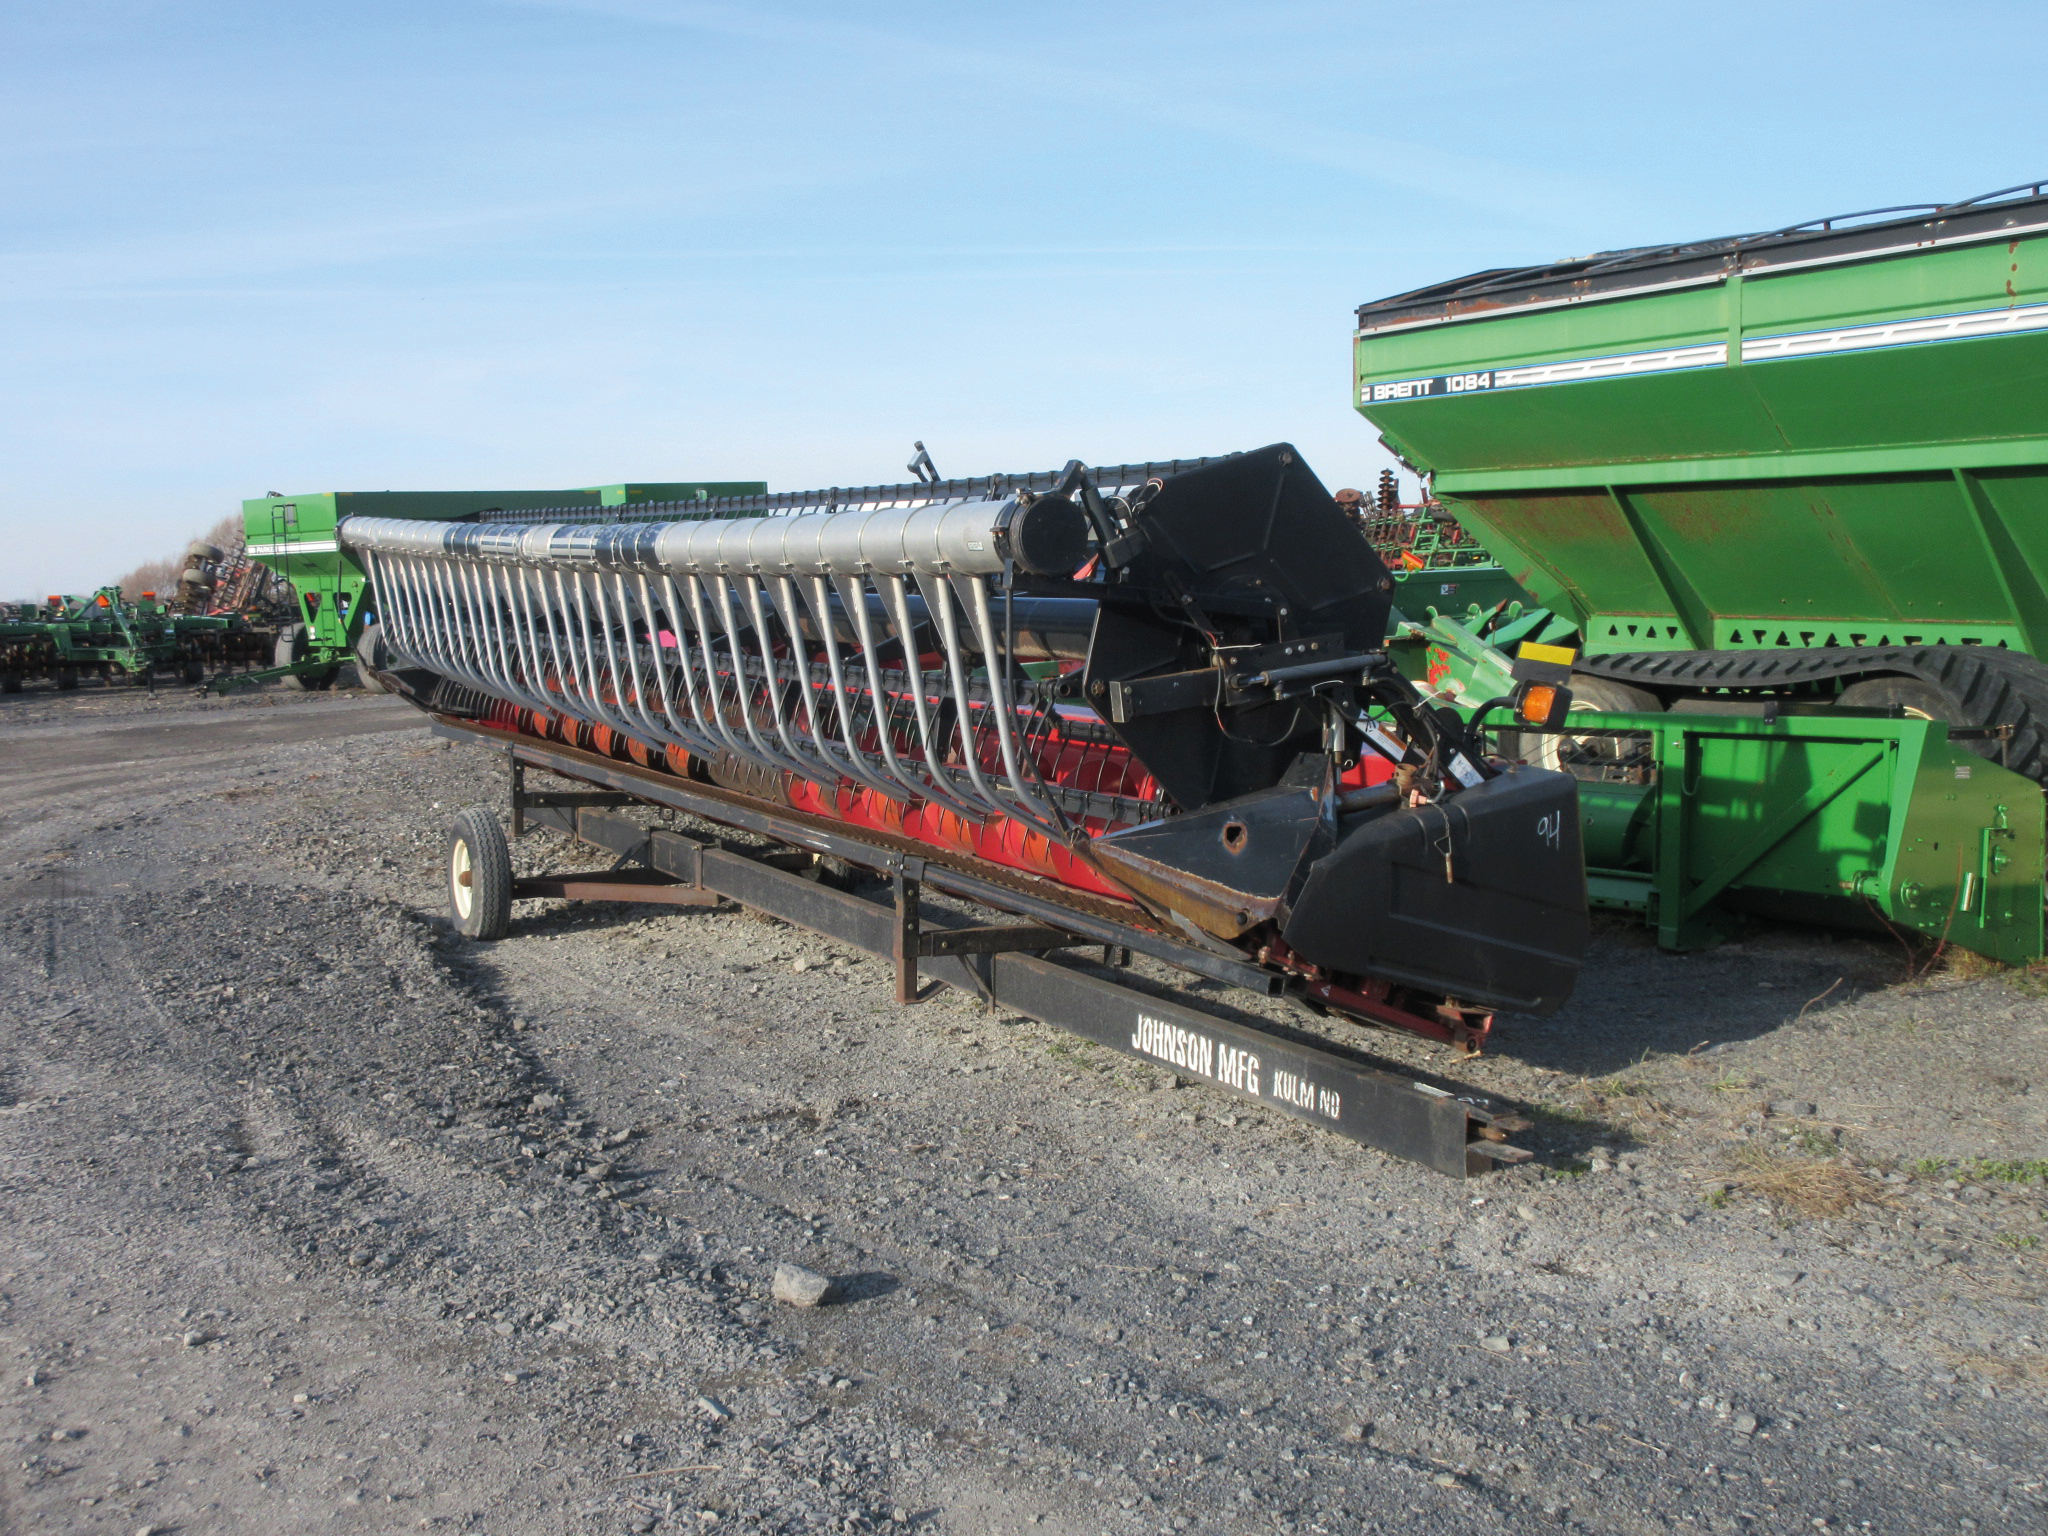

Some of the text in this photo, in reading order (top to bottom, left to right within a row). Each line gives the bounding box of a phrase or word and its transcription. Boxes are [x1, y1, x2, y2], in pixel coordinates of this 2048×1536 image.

[1374, 372, 1491, 400] BRENT 1084
[1537, 810, 1560, 851] 94
[1132, 1014, 1341, 1119] JOHNSON MFG KULM ND
